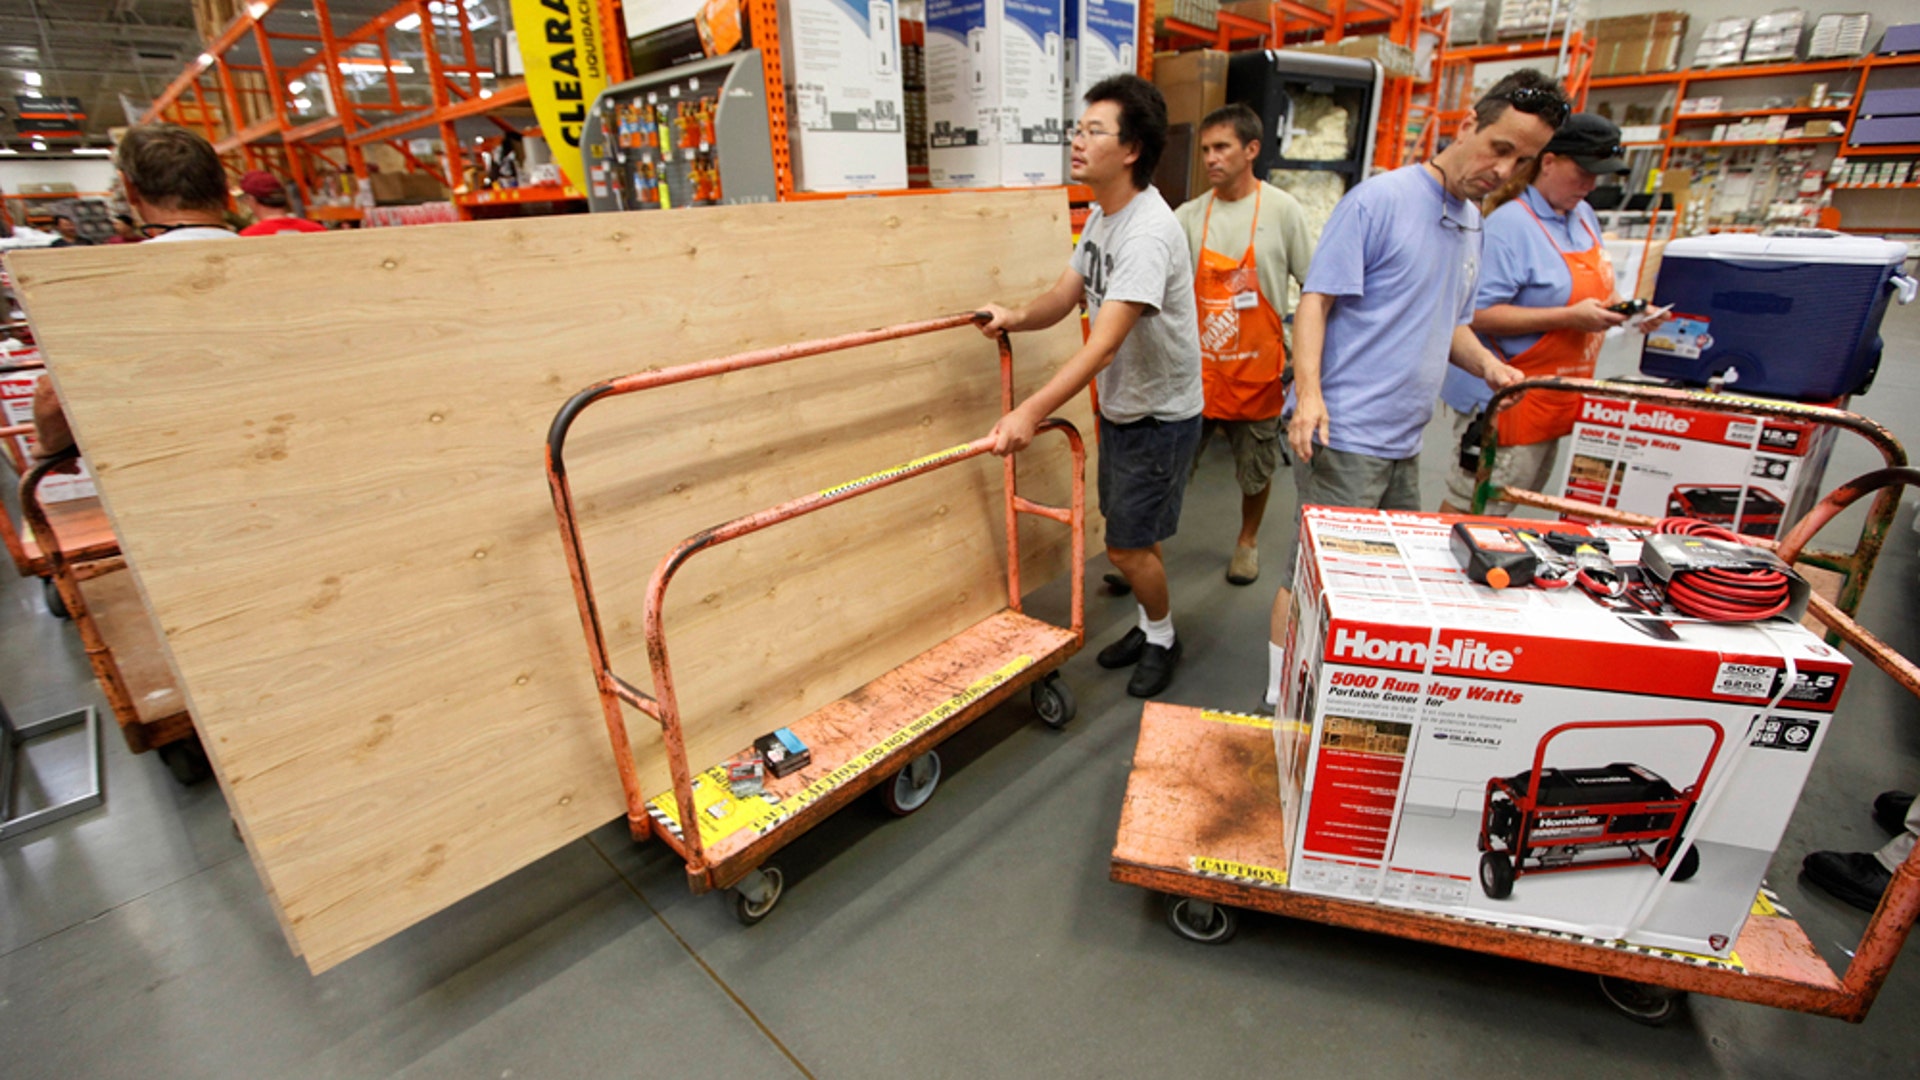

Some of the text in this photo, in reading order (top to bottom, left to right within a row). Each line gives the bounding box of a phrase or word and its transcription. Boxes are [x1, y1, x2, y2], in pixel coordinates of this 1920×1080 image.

[1201, 310, 1238, 350] HOME
[1212, 325, 1239, 352] DEPOT
[1582, 401, 1690, 433] Homelite
[1333, 628, 1515, 673] Homelite
[1727, 665, 1766, 674] 5000
[1330, 671, 1524, 705] 5000 Runing Watts
[1723, 679, 1762, 689] 6250
[1328, 687, 1444, 707] Portable Genertor
[884, 731, 909, 748] NOT
[1449, 733, 1502, 746] SUBARU
[1539, 815, 1599, 829] Homelite
